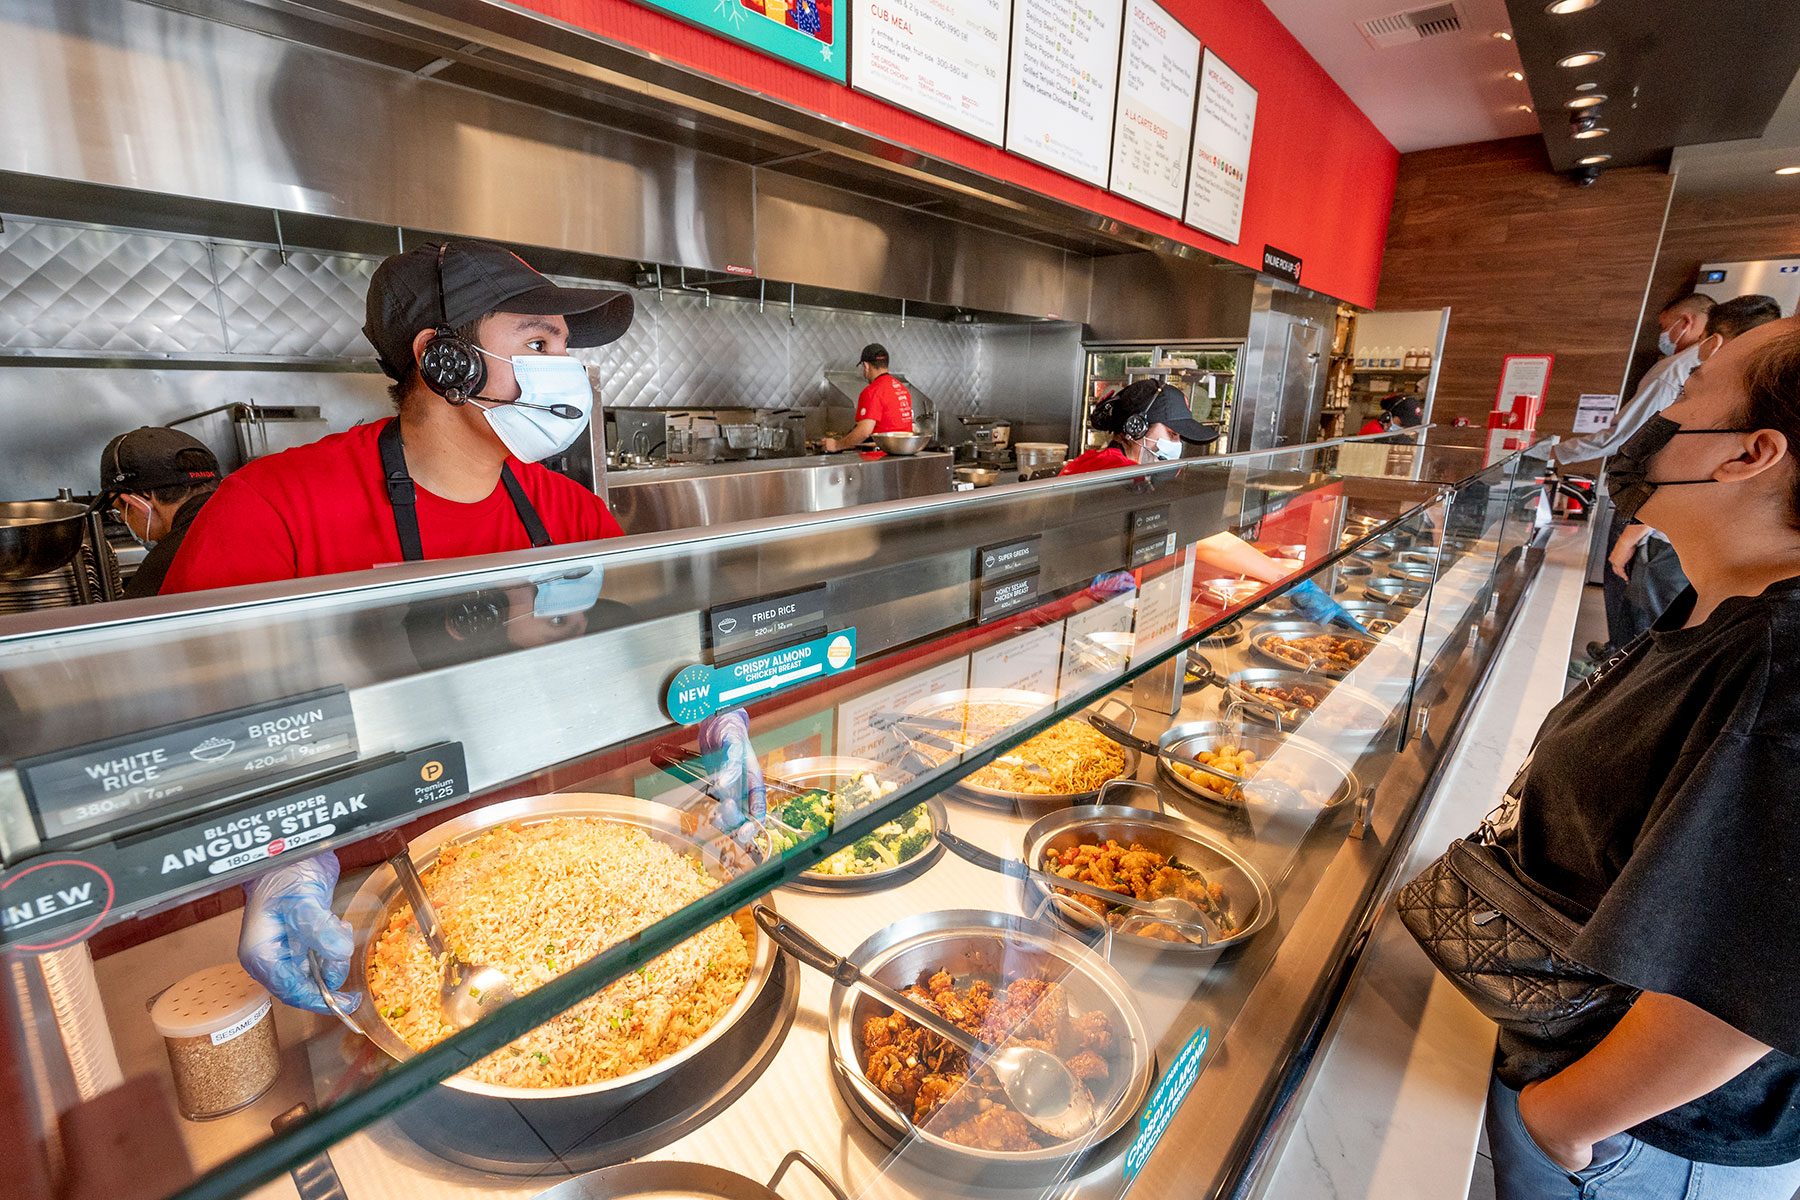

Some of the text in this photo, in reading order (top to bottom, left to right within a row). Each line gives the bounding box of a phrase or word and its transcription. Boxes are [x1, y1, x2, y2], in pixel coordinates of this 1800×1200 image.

[871, 4, 913, 34] CUB MEAL
[998, 552, 1012, 562] SUPER
[994, 593, 1013, 603] CHICKEN
[752, 603, 796, 623] FRIED RICE
[734, 657, 770, 677] CRISPY
[772, 647, 812, 667] ALMOND
[745, 660, 802, 682] CHICKEN BREAST
[679, 684, 711, 704] NEW
[248, 709, 324, 739] BROWN
[266, 726, 312, 748] RICE
[85, 748, 168, 780] WHITE
[426, 764, 439, 779] P
[102, 766, 161, 792] RICE
[414, 777, 454, 797] Premium
[203, 794, 327, 841] BLACK PEPPER
[160, 793, 369, 876] ANGUS STEAK
[227, 853, 251, 867] 180
[7, 882, 92, 925] NEW
[215, 1019, 252, 1042] SESAME
[1153, 1042, 1193, 1108] TRY OUR NEW
[1127, 1036, 1207, 1168] CRISPY ALMOND
[1135, 1065, 1198, 1169] CHICKEN BREAST
